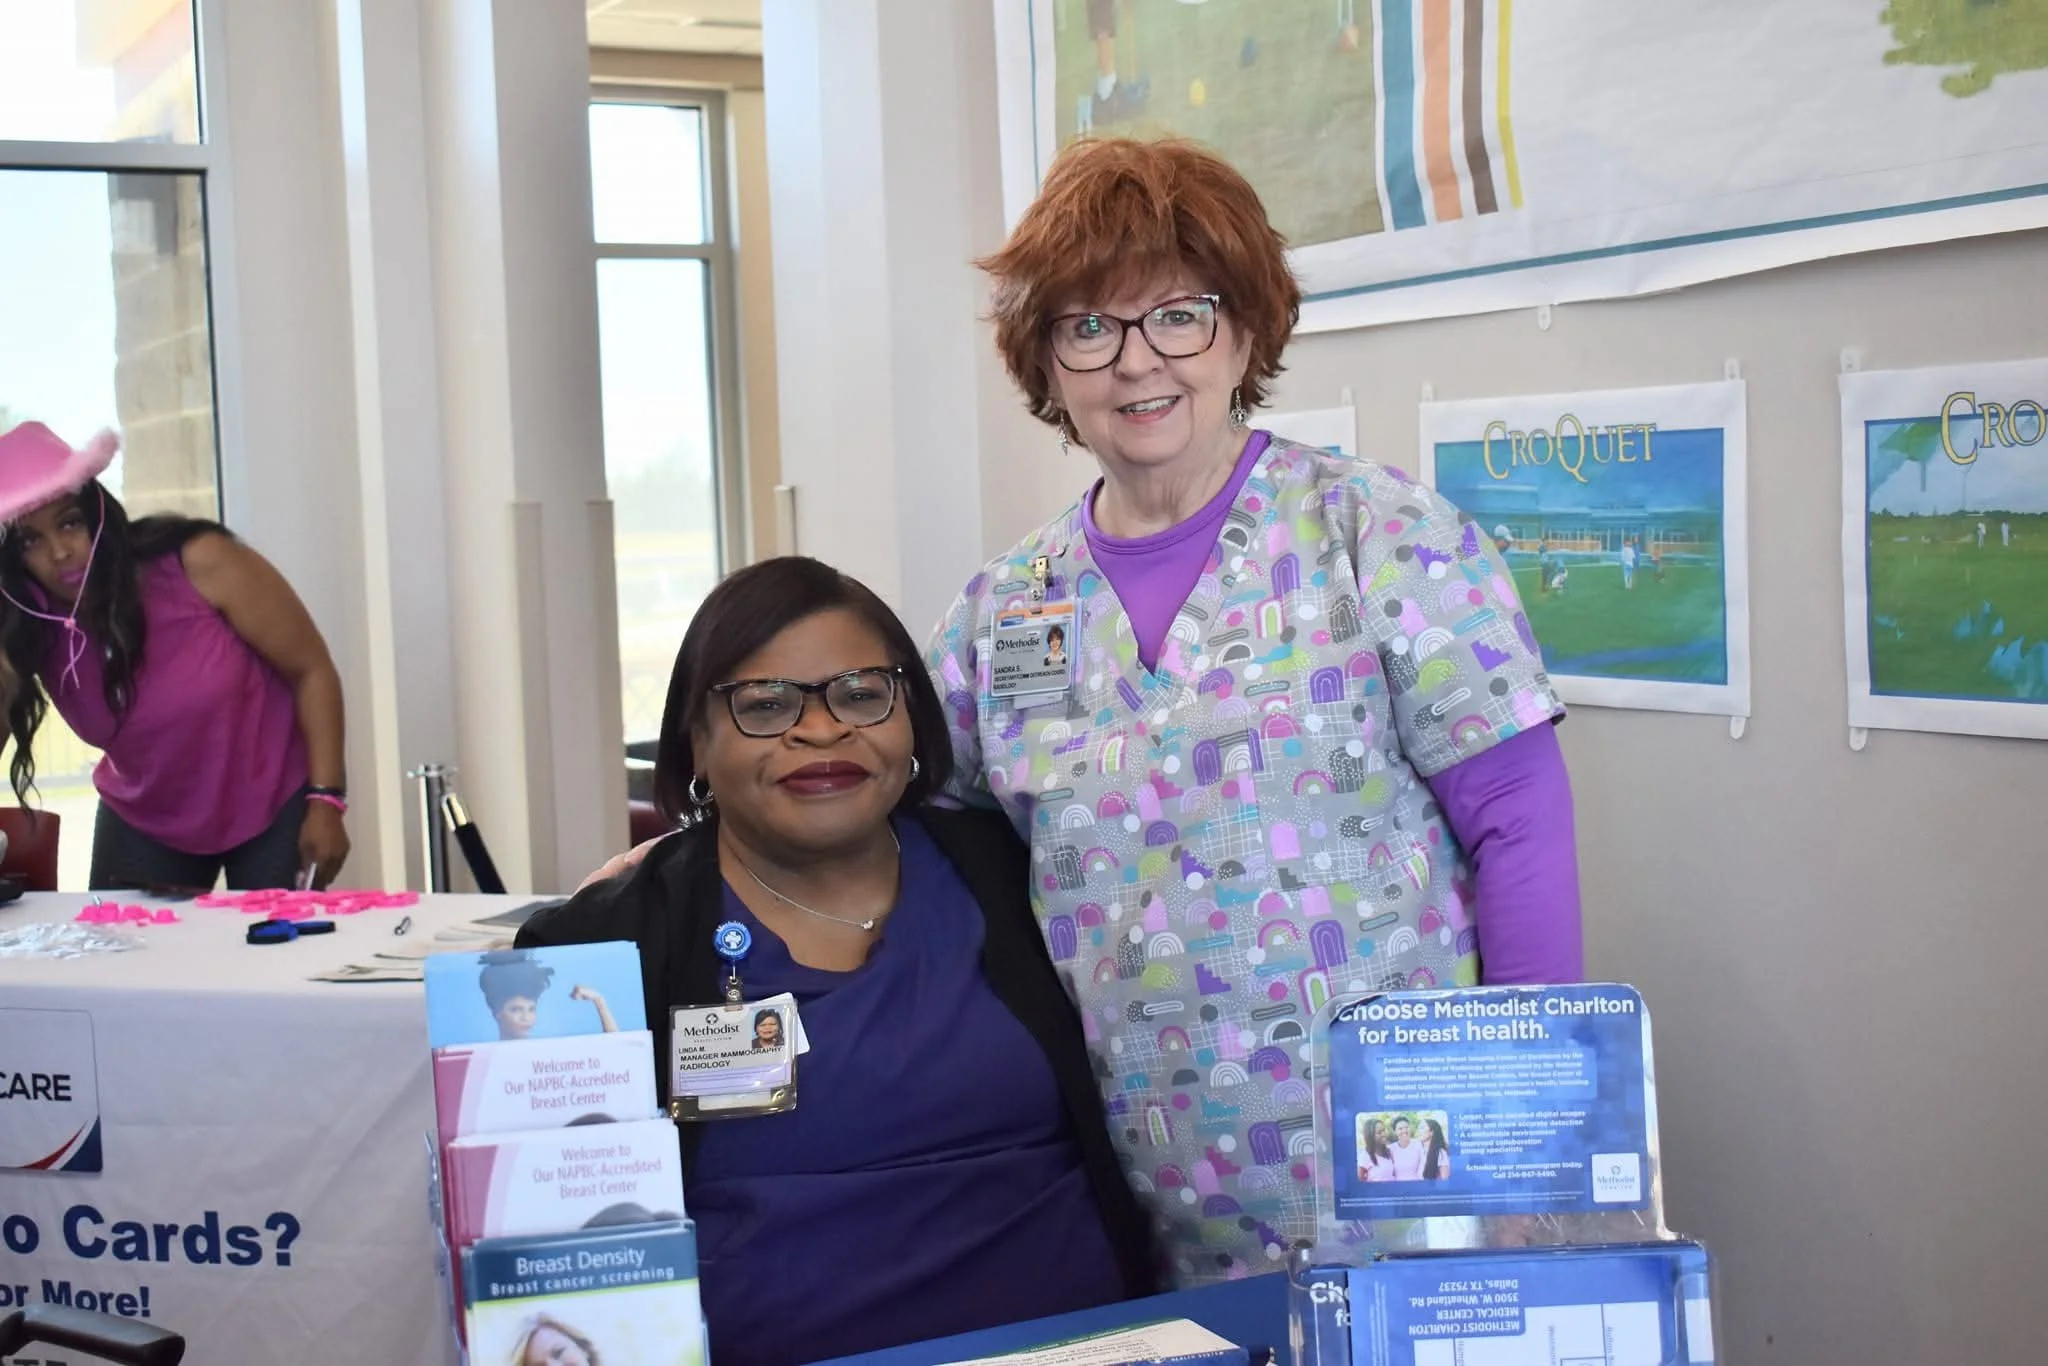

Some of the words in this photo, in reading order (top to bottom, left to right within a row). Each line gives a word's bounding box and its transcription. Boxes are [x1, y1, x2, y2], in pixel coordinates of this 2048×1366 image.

[1005, 637, 1040, 649] Methodist
[994, 665, 1016, 674] SANDRA
[1434, 999, 1539, 1018] Methodist
[1544, 996, 1635, 1016] Charlton
[684, 1024, 741, 1037] Methodist
[1358, 1026, 1389, 1045] for
[1394, 1024, 1460, 1043] breast
[1466, 1020, 1550, 1041] health.
[680, 1053, 719, 1062] MANAGER
[721, 1047, 781, 1058] MAMMOGRAPHY
[531, 1059, 586, 1075] Welcome
[588, 1057, 601, 1069] to
[680, 1060, 731, 1071] RADIOLOGY
[504, 1081, 525, 1095] Our
[528, 1070, 630, 1092] NAPBC-Accredited
[530, 1095, 567, 1110] Breast
[569, 1092, 606, 1106] Center
[561, 1145, 616, 1161] Welcome
[618, 1144, 631, 1157] to
[533, 1168, 554, 1183] Our
[560, 1183, 597, 1199] Breast
[600, 1180, 637, 1195] Center
[63, 1204, 301, 1267] Cards?
[516, 1254, 573, 1276] Breast
[577, 1248, 646, 1271] Density
[490, 1277, 539, 1297] Breast
[544, 1275, 594, 1291] cancer
[601, 1265, 675, 1280] screening
[1438, 1281, 1469, 1292] 75237
[1470, 1280, 1484, 1291] TX
[1485, 1279, 1518, 1291] Dallas,
[41, 1279, 150, 1317] More!
[1408, 1297, 1425, 1308] Rd.
[1427, 1294, 1478, 1307] Wheatland
[1480, 1293, 1494, 1305] W.
[1495, 1292, 1519, 1303] 3500
[1436, 1308, 1473, 1320] CENTER
[1475, 1306, 1519, 1318] MEDICAL
[1408, 1323, 1461, 1336] CHARLTON
[1462, 1320, 1520, 1333] METHODIST
